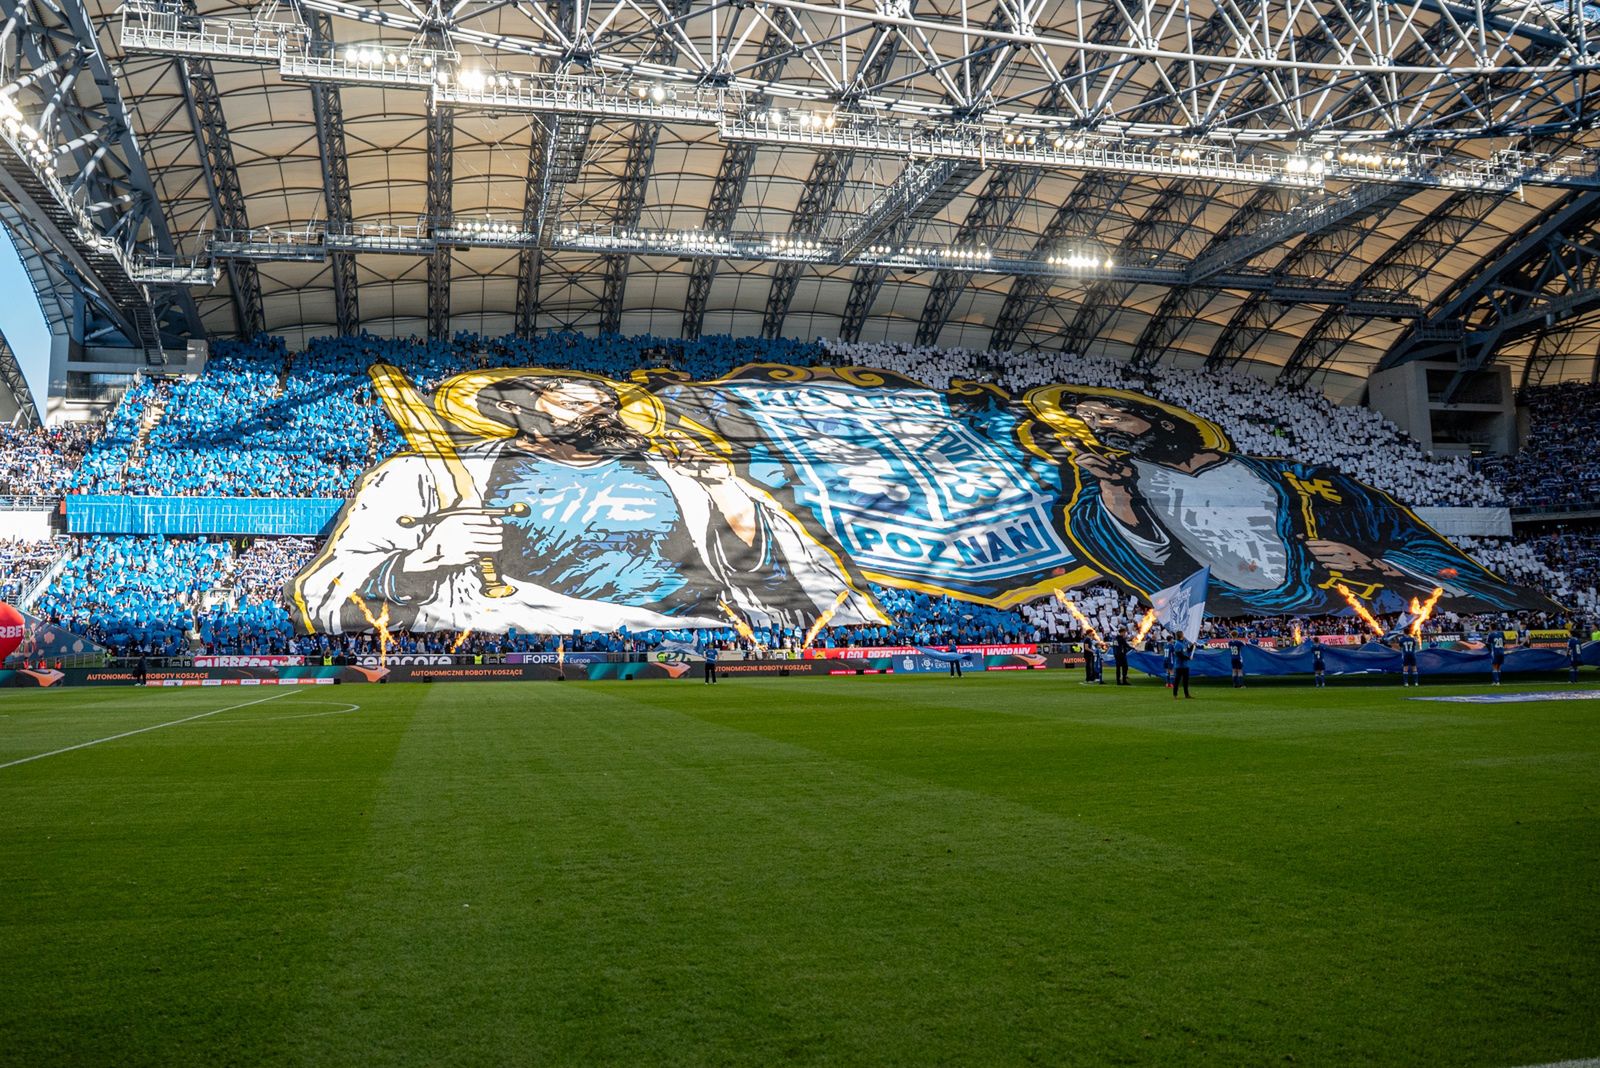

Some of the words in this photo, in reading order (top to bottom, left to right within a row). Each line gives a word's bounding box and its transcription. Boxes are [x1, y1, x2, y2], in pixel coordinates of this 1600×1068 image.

[851, 518, 1044, 566] POZNAŃ
[1403, 641, 1413, 652] 17
[570, 657, 591, 665] Europe
[935, 661, 974, 669] EKSTLASA
[175, 672, 209, 680] KOSZĄCE
[411, 669, 465, 677] AUTONOMICZNE
